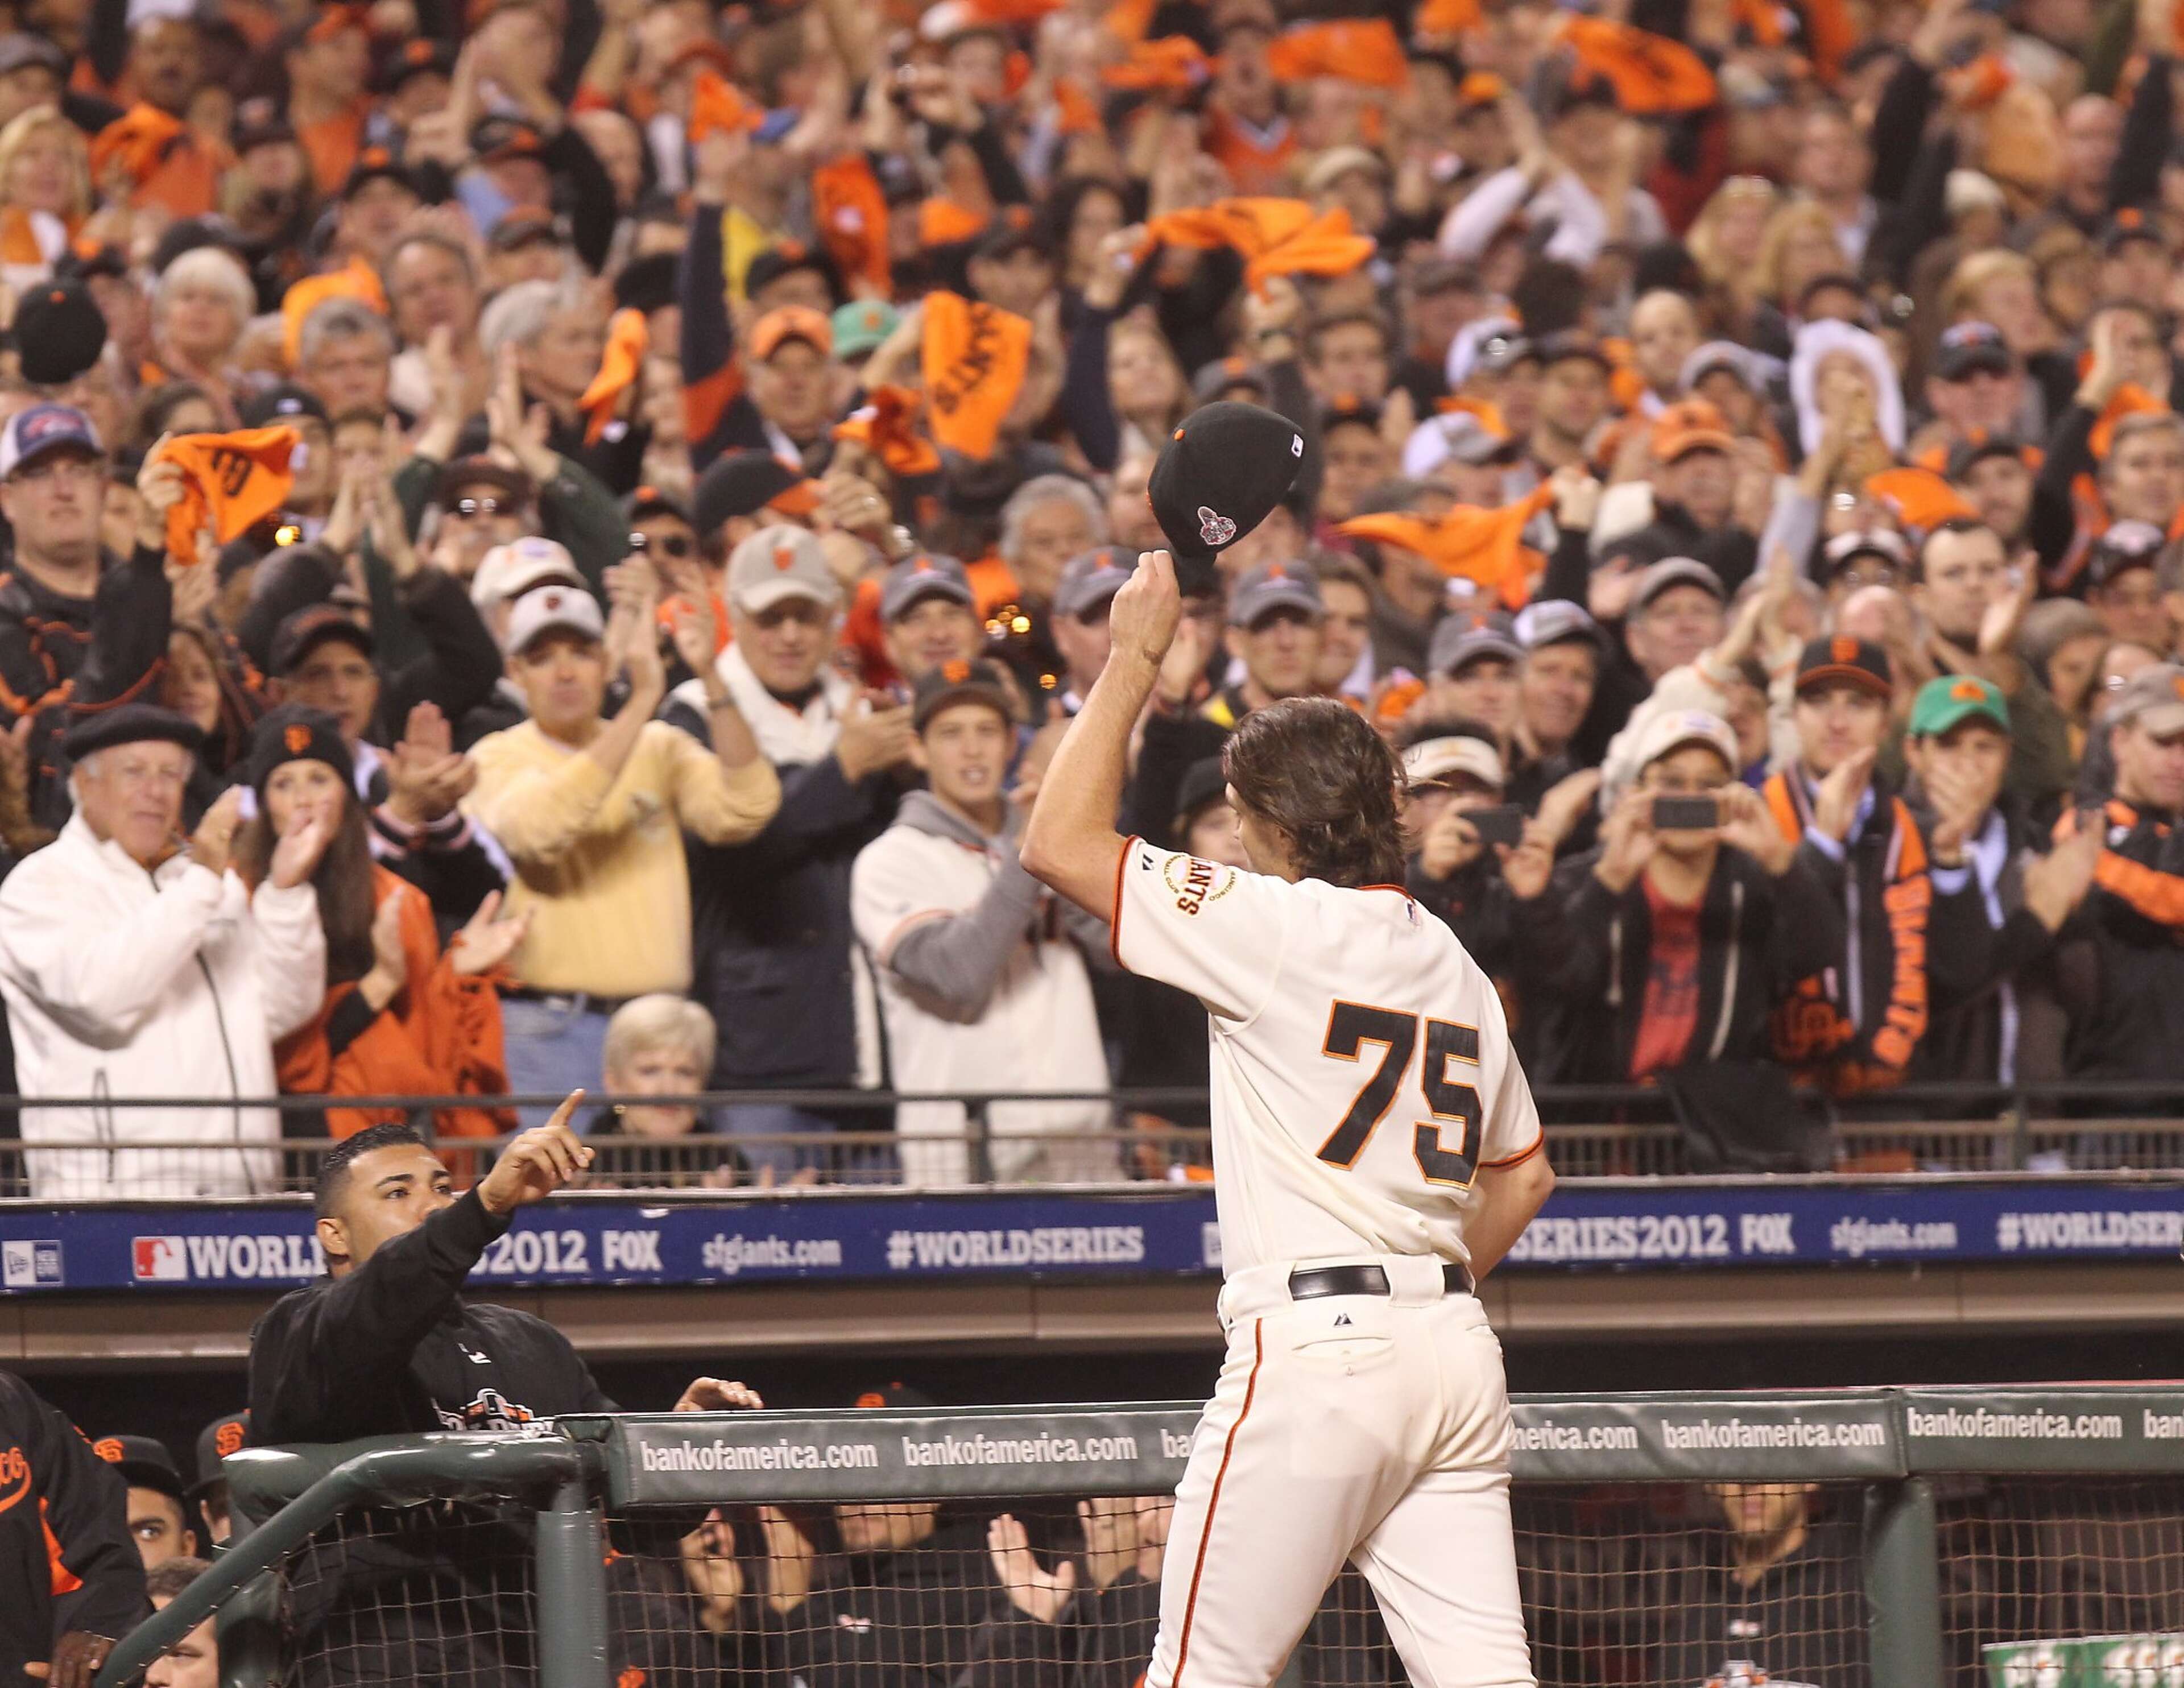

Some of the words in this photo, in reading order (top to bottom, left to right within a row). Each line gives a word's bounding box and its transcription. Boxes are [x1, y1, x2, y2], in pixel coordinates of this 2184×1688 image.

[1314, 998, 1483, 1190] 75
[601, 1230, 664, 1272] FOX
[702, 1232, 842, 1275] sfgiants.com
[887, 1226, 1145, 1269] #WORLDSERIES
[1740, 1213, 1796, 1255] FOX
[1830, 1216, 1958, 1258] sfgiants.com
[1662, 1417, 1886, 1449] bankofamerica.com
[1907, 1407, 2123, 1438] bankofamerica.com
[640, 1438, 879, 1471] bankofamerica.com
[901, 1432, 1138, 1466] bankofamerica.com
